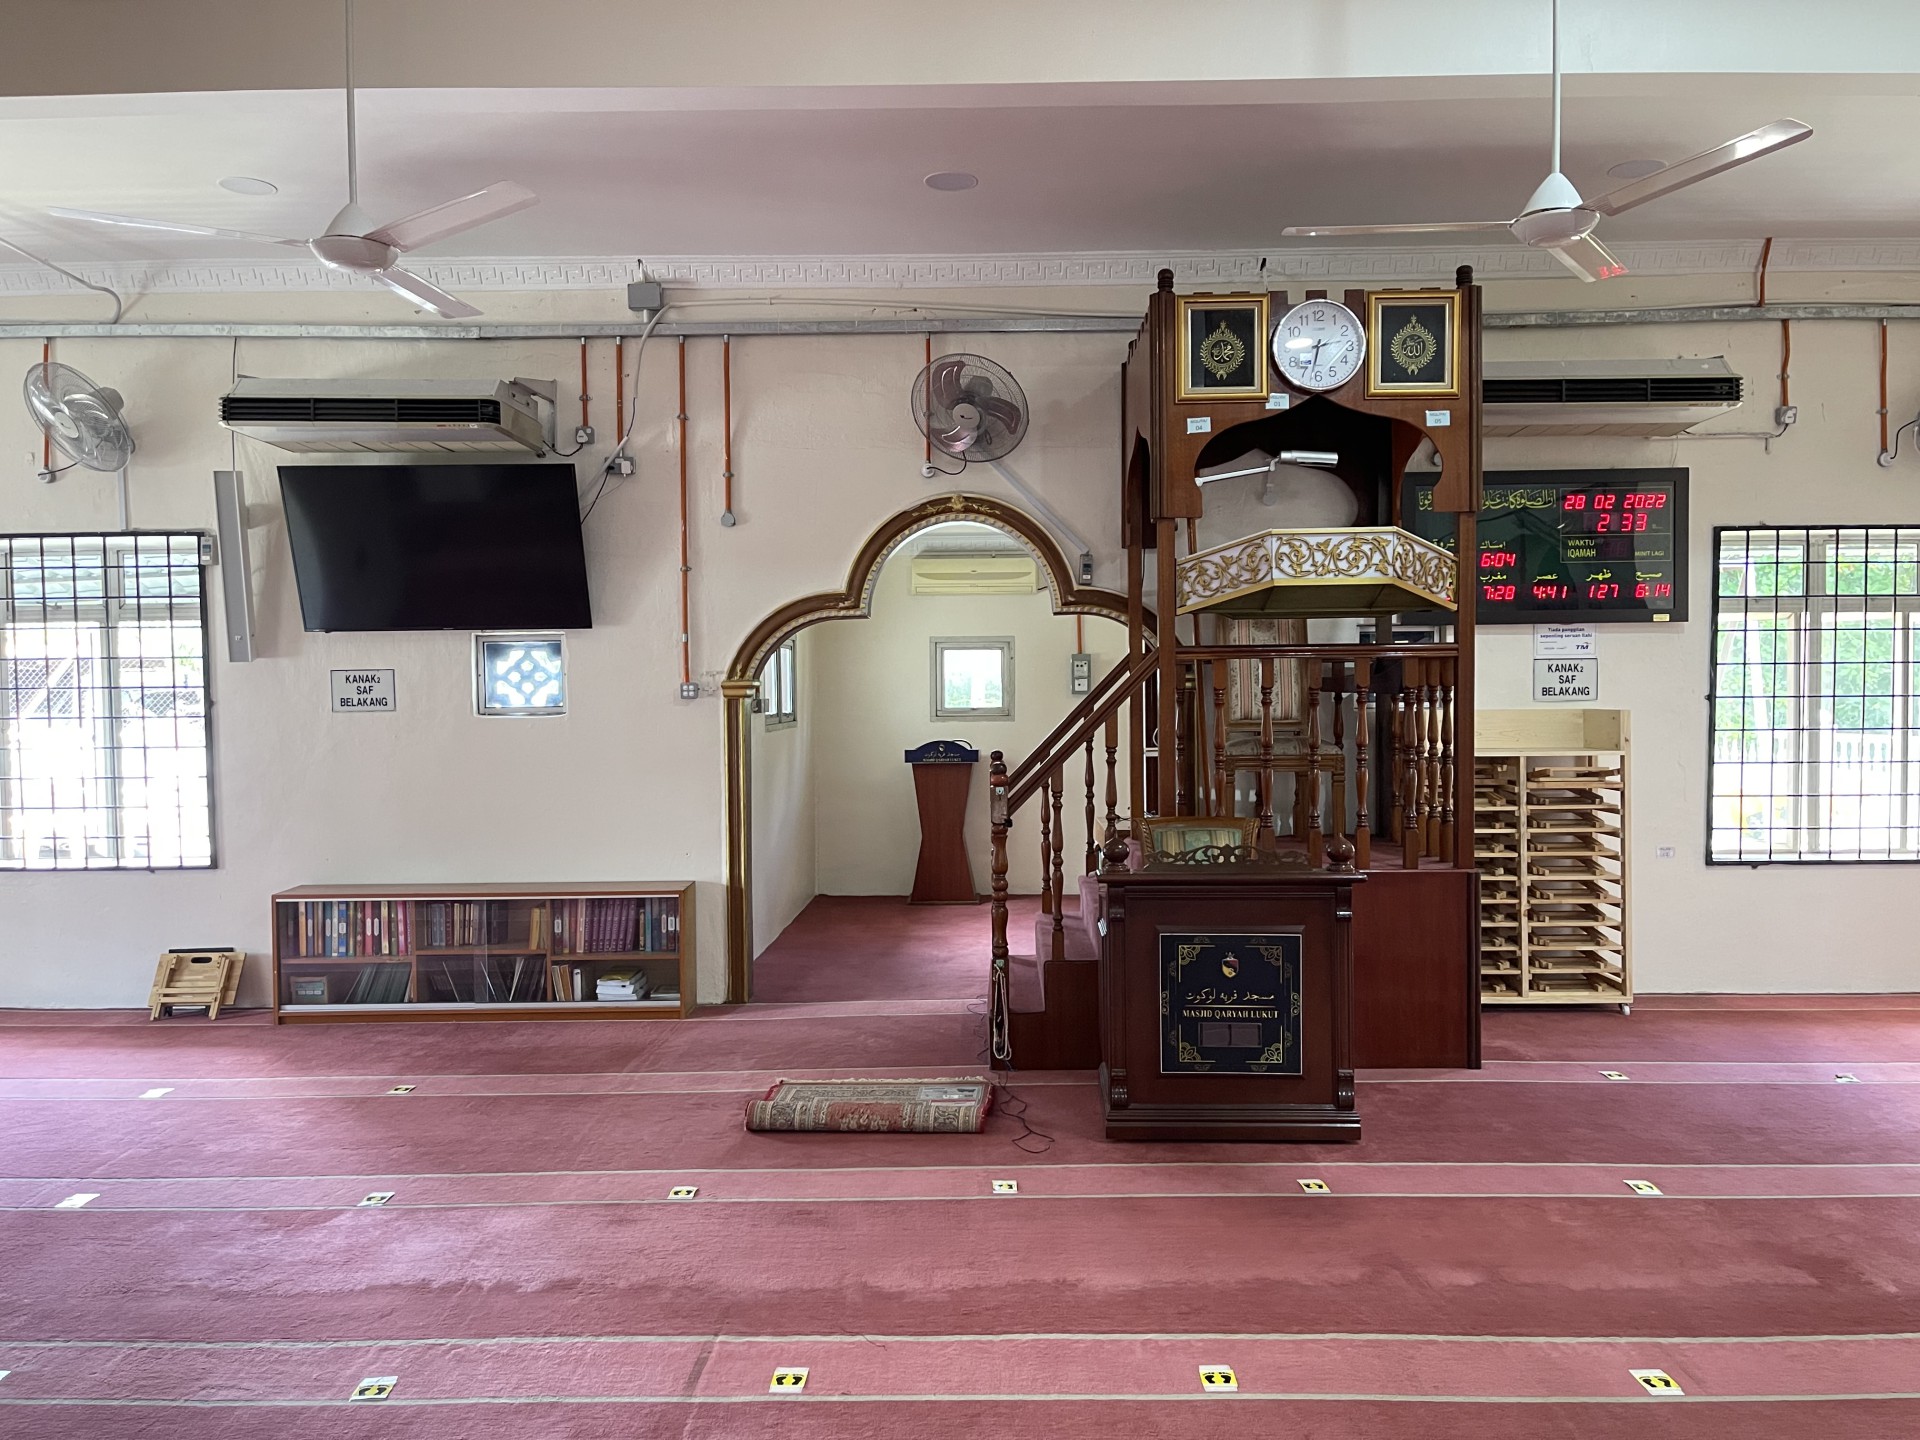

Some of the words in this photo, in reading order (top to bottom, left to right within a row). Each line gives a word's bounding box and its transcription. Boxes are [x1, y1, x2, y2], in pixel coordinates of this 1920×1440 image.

[1299, 314, 1309, 326] 11
[1312, 310, 1325, 322] 12
[1332, 314, 1337, 326] 1
[1287, 326, 1301, 338] 10
[1340, 325, 1349, 337] 2
[1346, 340, 1354, 352] 3
[1288, 356, 1297, 368] 8
[1340, 354, 1349, 365] 4
[1300, 366, 1308, 378] 7
[1314, 371, 1323, 382] 6
[1329, 366, 1337, 378] 5
[1564, 495, 1586, 510] 28
[1594, 494, 1616, 509] 02
[1624, 494, 1667, 509] 2022
[1567, 539, 1595, 547] WAKTU
[1480, 552, 1516, 567] 6:04
[1567, 549, 1596, 558] IQAMAH
[1479, 572, 1507, 583] مغرب
[1532, 572, 1559, 583] عصر
[1585, 568, 1612, 581] ظهر
[1635, 571, 1663, 581] صبح
[1482, 585, 1516, 600] 7:28
[1532, 585, 1569, 599] 4:41
[1635, 583, 1671, 598] 6:14
[1558, 675, 1577, 685] SAF
[356, 685, 374, 695] SAF
[1541, 686, 1590, 697] BELAKANG
[340, 697, 388, 707] BELAKANG
[1242, 991, 1275, 1001] مسجد
[1182, 1009, 1213, 1018] MASJID
[1214, 1009, 1249, 1020] QARYAH
[1250, 1010, 1279, 1019] LUKUT
